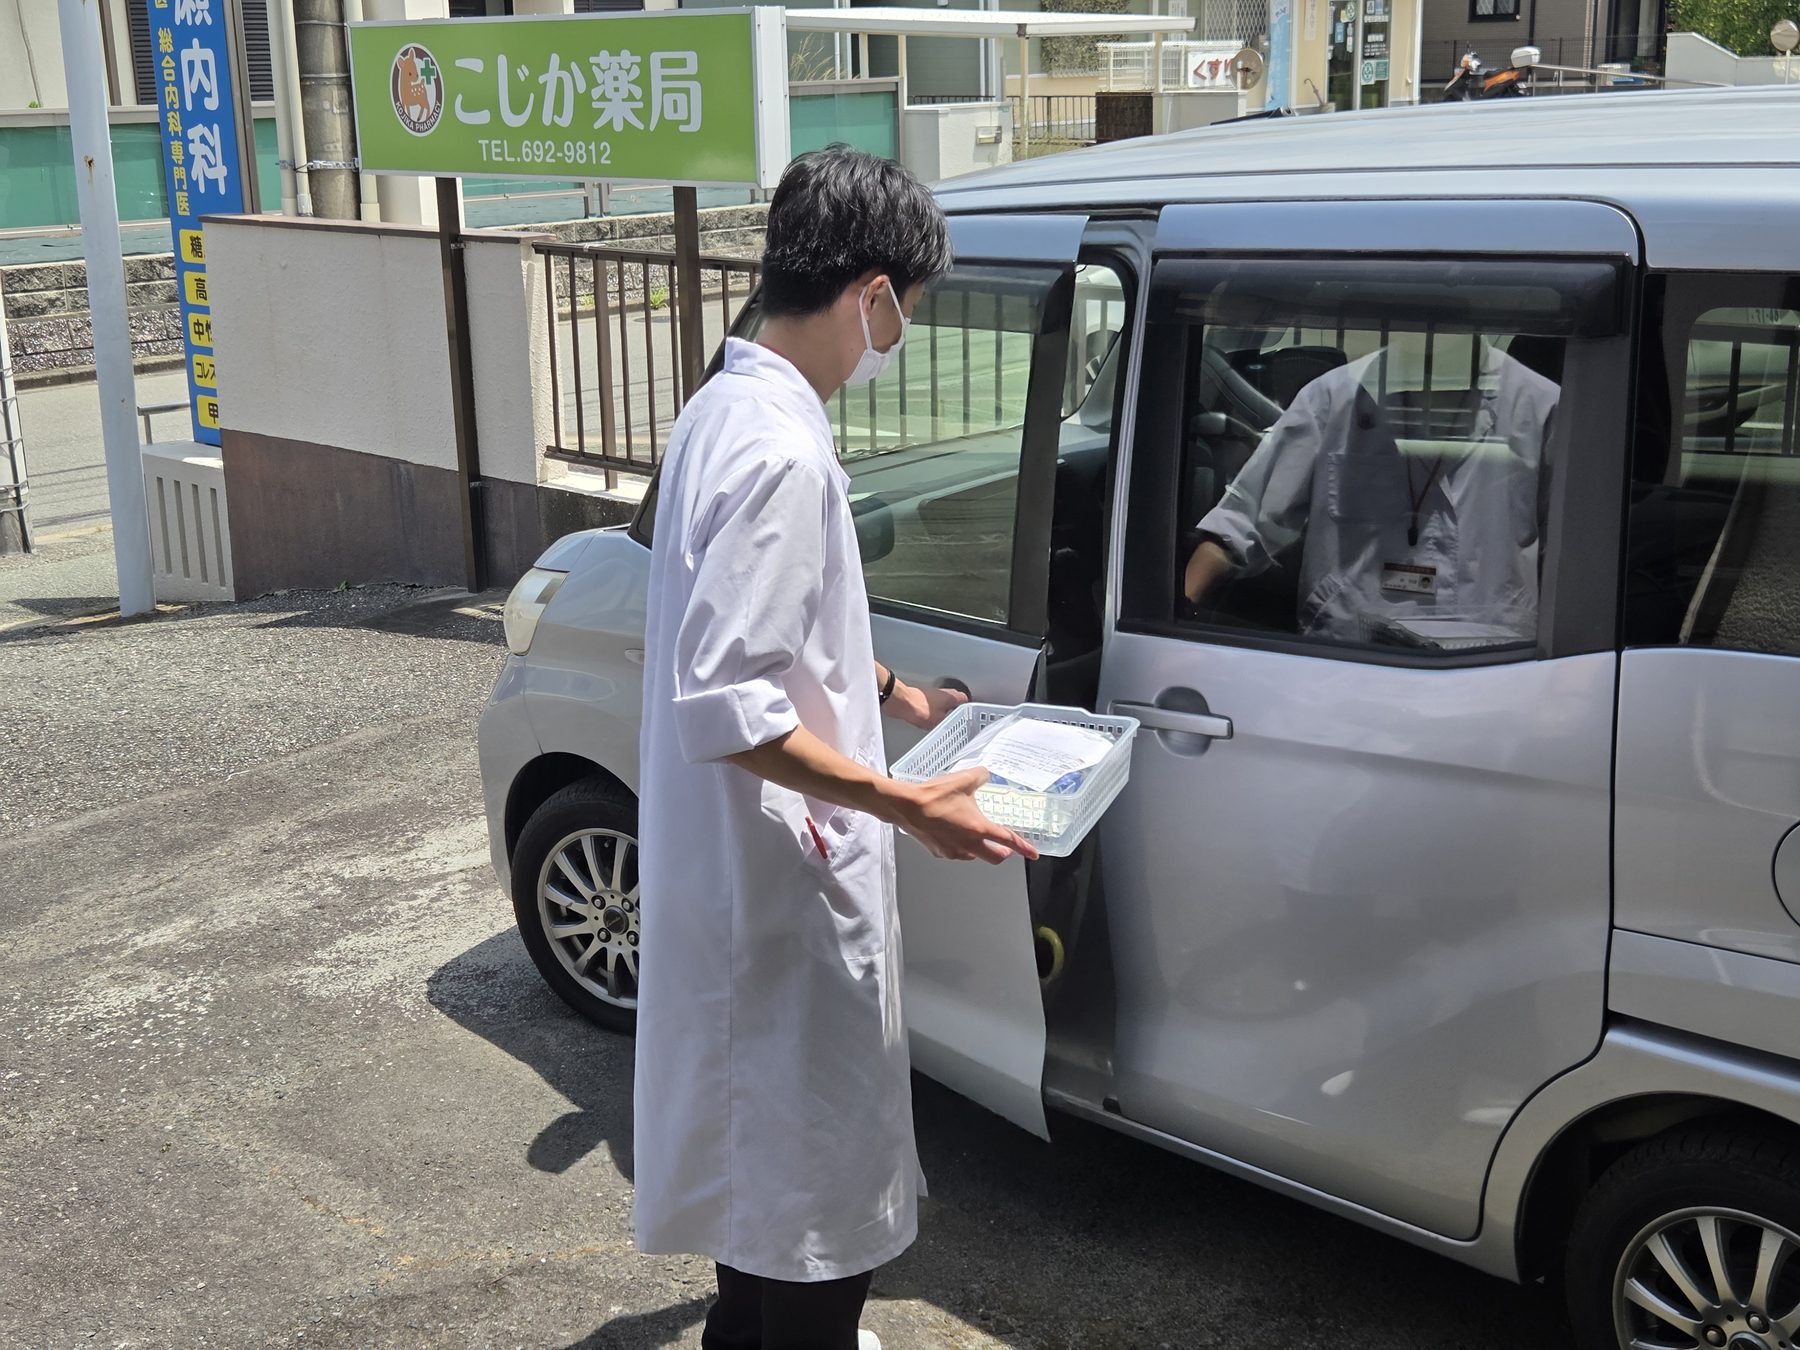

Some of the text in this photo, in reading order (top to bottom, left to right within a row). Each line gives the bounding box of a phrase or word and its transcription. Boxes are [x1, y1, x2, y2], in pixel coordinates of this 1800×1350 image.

[395, 100, 441, 132] KOJIKA PHARMACY
[454, 49, 703, 133] こじか薬局
[158, 27, 190, 217] 総合内科専門医
[478, 139, 611, 165] TEL.692-9812
